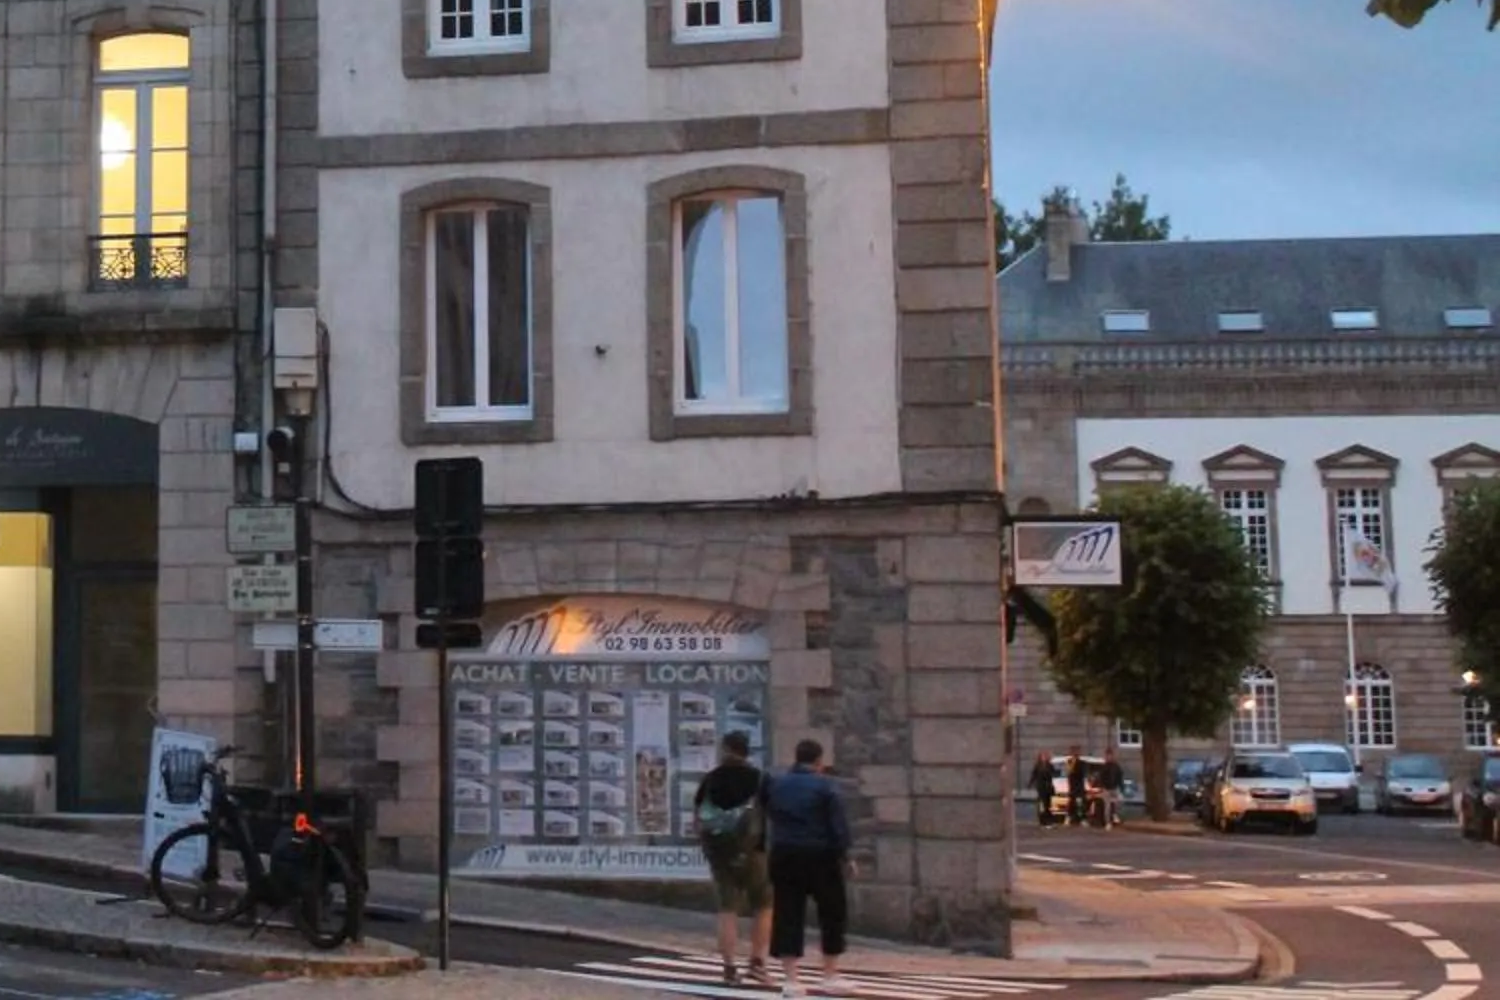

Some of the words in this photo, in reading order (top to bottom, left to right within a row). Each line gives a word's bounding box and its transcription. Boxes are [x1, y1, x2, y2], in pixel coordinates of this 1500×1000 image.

[605, 636, 624, 651] 02
[653, 637, 673, 651] 63
[451, 663, 527, 684] ACHAT
[549, 662, 625, 684] VENTE
[646, 662, 766, 684] LOCATION
